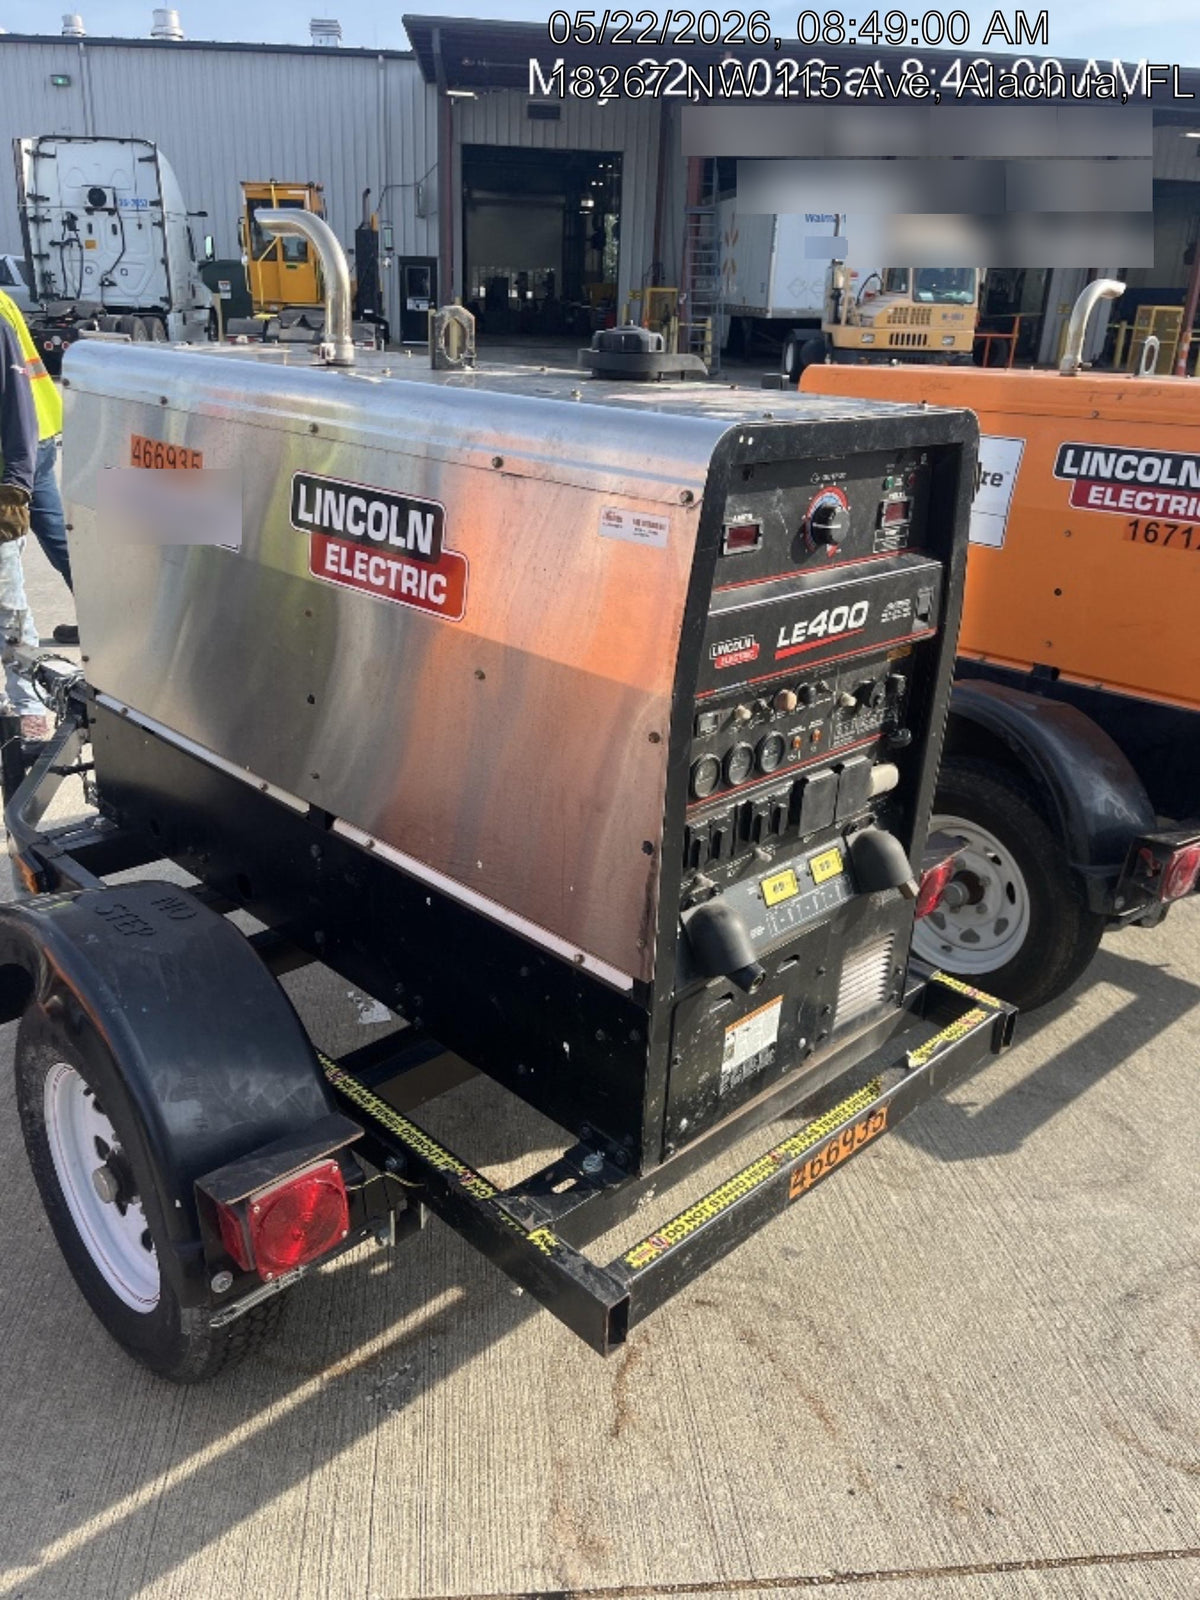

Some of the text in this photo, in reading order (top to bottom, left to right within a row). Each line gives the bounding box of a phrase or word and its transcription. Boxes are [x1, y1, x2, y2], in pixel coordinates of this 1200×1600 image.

[1062, 448, 1200, 488] LINCOLN
[298, 483, 434, 556] LINCOLN
[1087, 484, 1200, 518] ELECTRI
[1128, 518, 1200, 551] 1671
[324, 541, 448, 606] ELECTRIC
[712, 637, 752, 657] LINCOLN
[776, 600, 869, 648] LE400
[792, 1109, 885, 1190] 466935
[665, 1223, 686, 1239] DO
[686, 1204, 711, 1225] NOT
[708, 1179, 746, 1209] STAND
